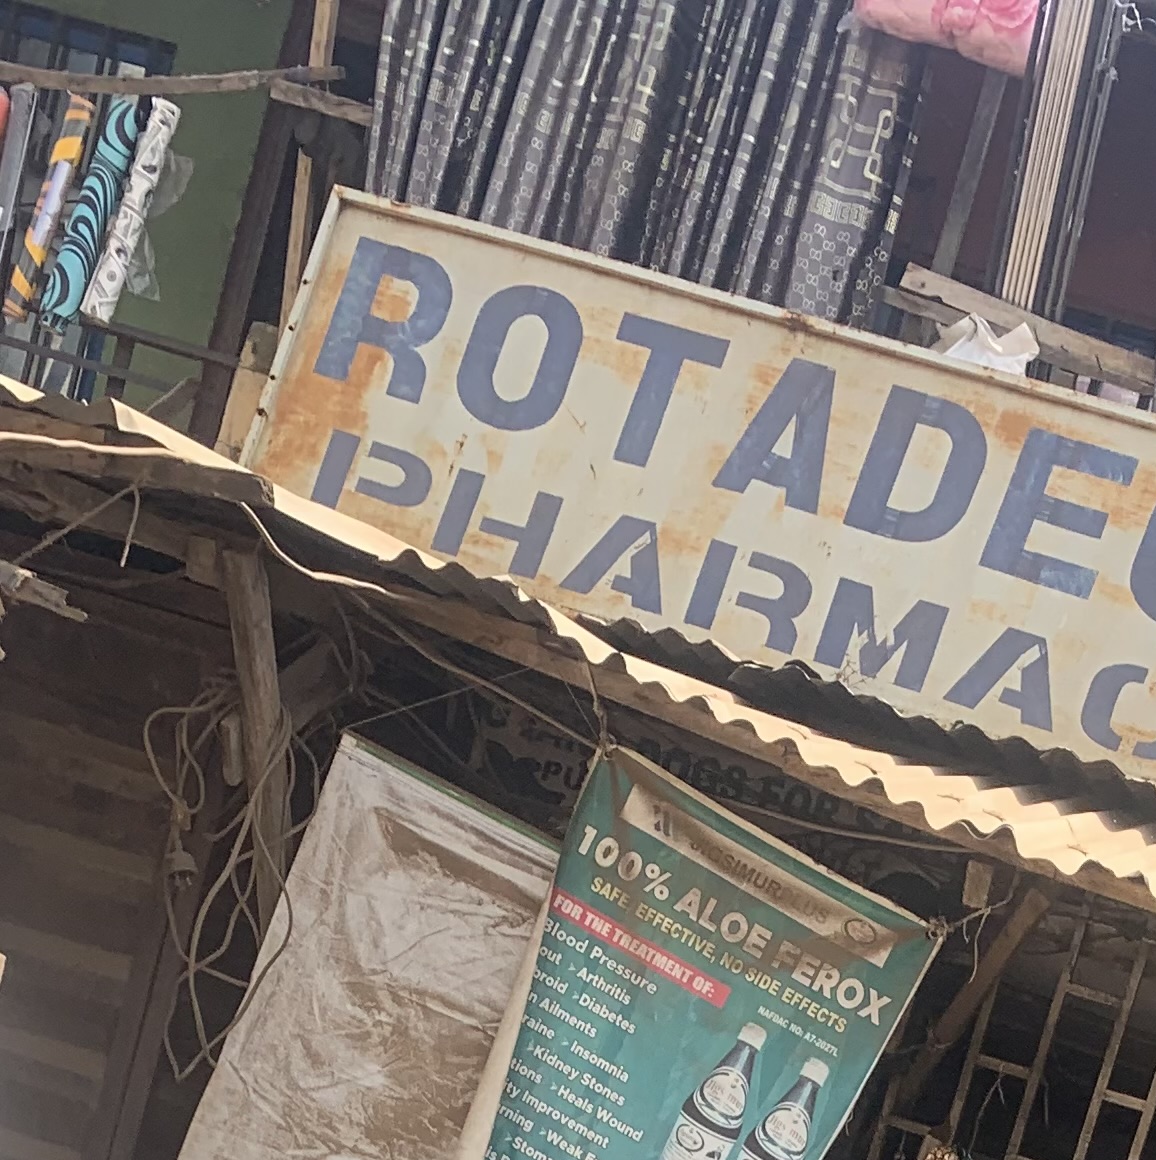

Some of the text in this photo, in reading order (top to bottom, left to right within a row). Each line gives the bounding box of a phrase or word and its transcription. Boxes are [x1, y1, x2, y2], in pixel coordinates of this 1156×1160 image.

[552, 893, 716, 999] FOR THE TREATMENT OF:
[576, 824, 892, 1026] 100% ALOE FEROX
[543, 917, 658, 995] Blood Pressure
[635, 902, 716, 964] EFFECTIVE,
[719, 951, 744, 975] NO
[744, 966, 782, 997] SIDE
[780, 986, 848, 1033] EFFECTS
[576, 967, 632, 1006] Arthritis
[578, 993, 638, 1035] Diabetes
[539, 997, 599, 1039] Ailments
[757, 1005, 790, 1029] NAFDAC
[533, 1044, 626, 1107] Kidney Stones
[569, 1040, 629, 1083] Insomnia
[510, 1057, 543, 1084] tions
[557, 1084, 594, 1114] Heals
[595, 1106, 644, 1142] Wound
[521, 1090, 610, 1150] Improvement
[546, 1129, 584, 1160] Weak
